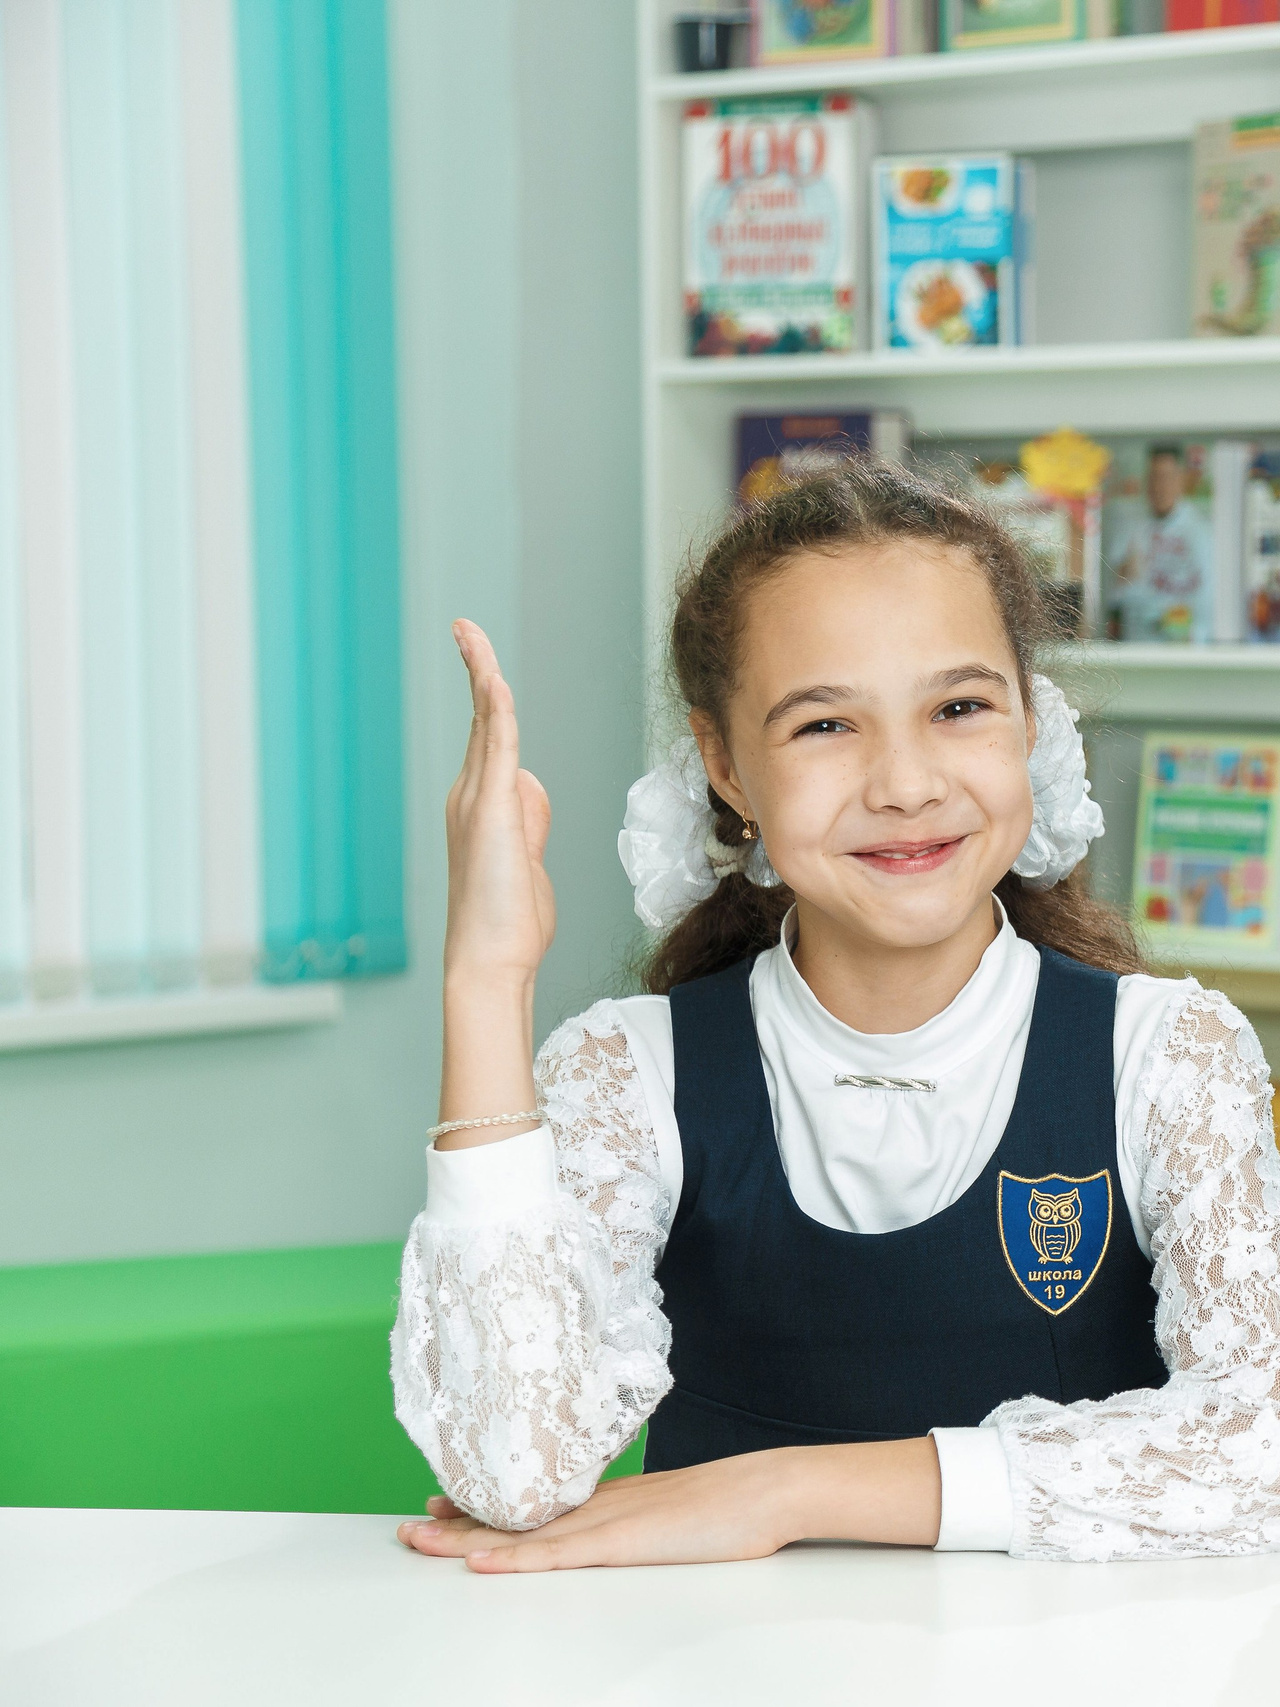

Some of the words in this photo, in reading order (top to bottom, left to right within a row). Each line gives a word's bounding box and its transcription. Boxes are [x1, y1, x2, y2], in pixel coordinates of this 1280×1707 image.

[714, 120, 828, 186] 100
[1028, 1268, 1082, 1282] школа
[1044, 1284, 1066, 1300] 19
